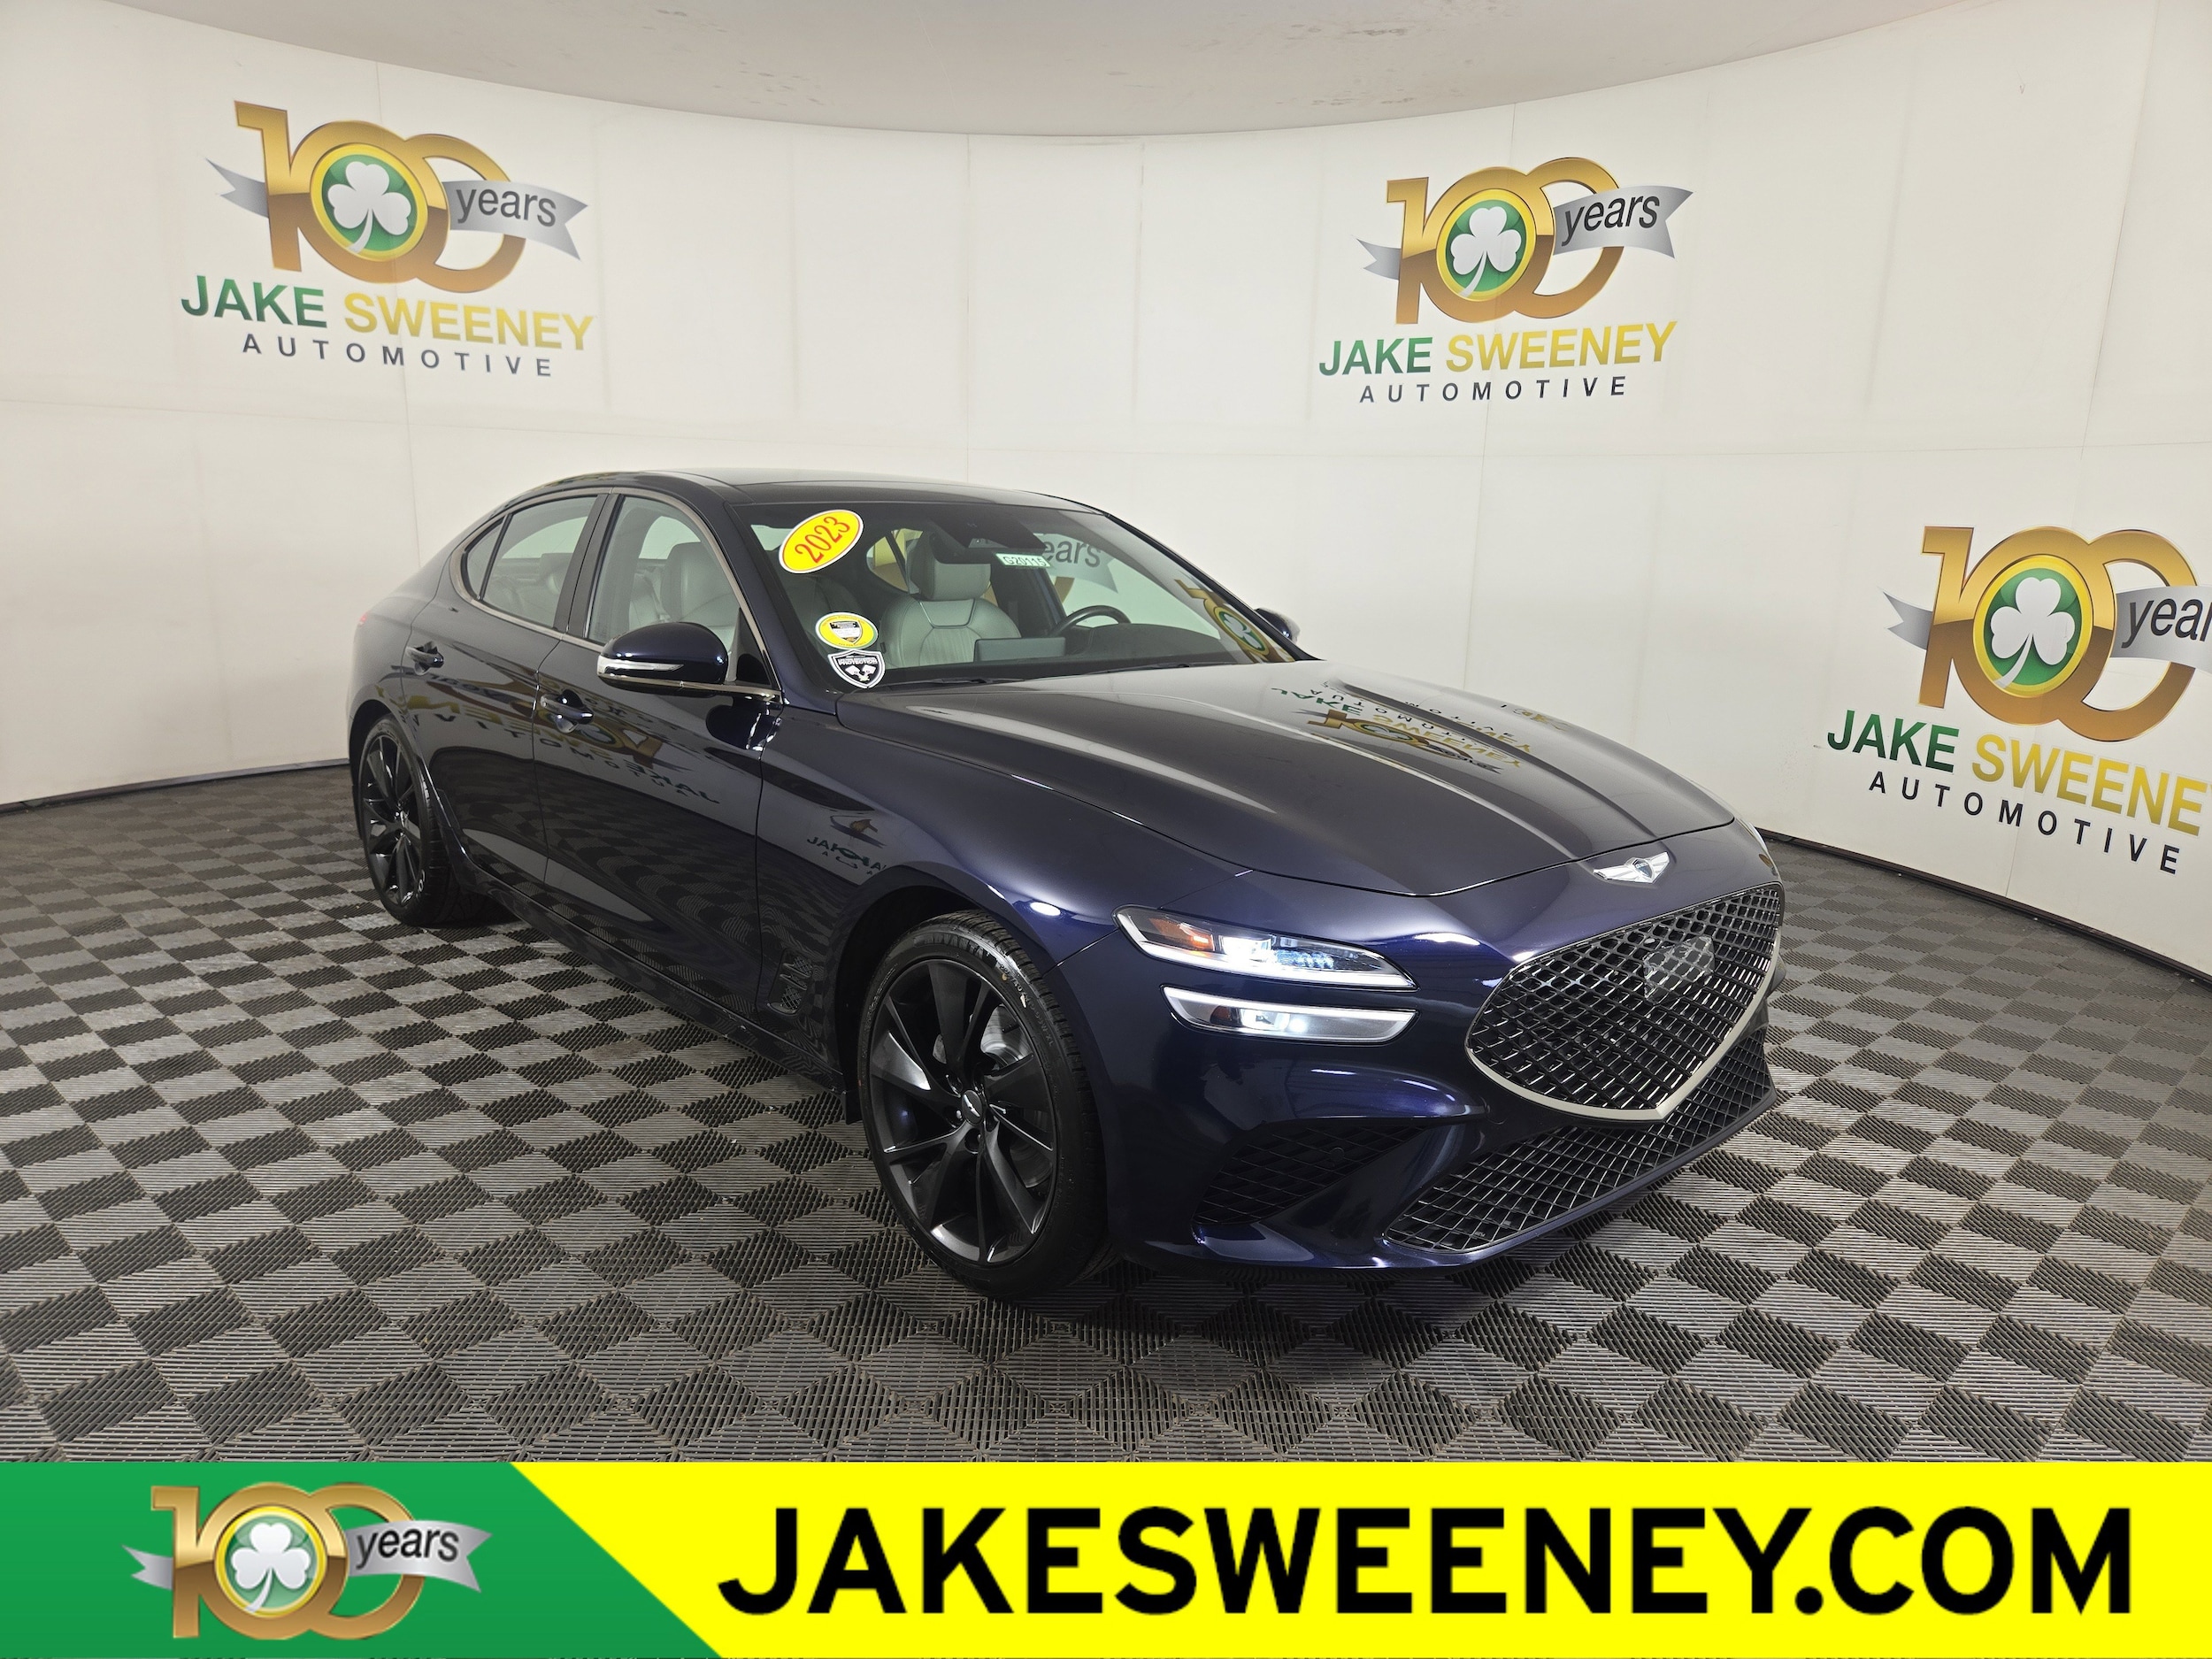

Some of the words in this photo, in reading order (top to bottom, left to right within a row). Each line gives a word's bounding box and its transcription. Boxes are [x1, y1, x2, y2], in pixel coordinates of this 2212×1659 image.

[455, 187, 557, 228] years
[1561, 196, 1661, 247] years
[180, 274, 327, 329] JAKE
[343, 293, 594, 351] SWEENEY
[242, 333, 552, 378] AUTOMOTIVE
[1318, 336, 1433, 377] JAKE
[1446, 320, 1678, 373] SWEENEY
[1359, 376, 1627, 404] AUTOMOTIVE
[794, 516, 851, 564] 2023
[1042, 540, 1102, 568] ears
[2121, 598, 2212, 649] year
[1826, 709, 1960, 773] JAKE
[1971, 733, 2212, 837] SWEENE
[1869, 770, 2181, 875] AUTOMOTIVE
